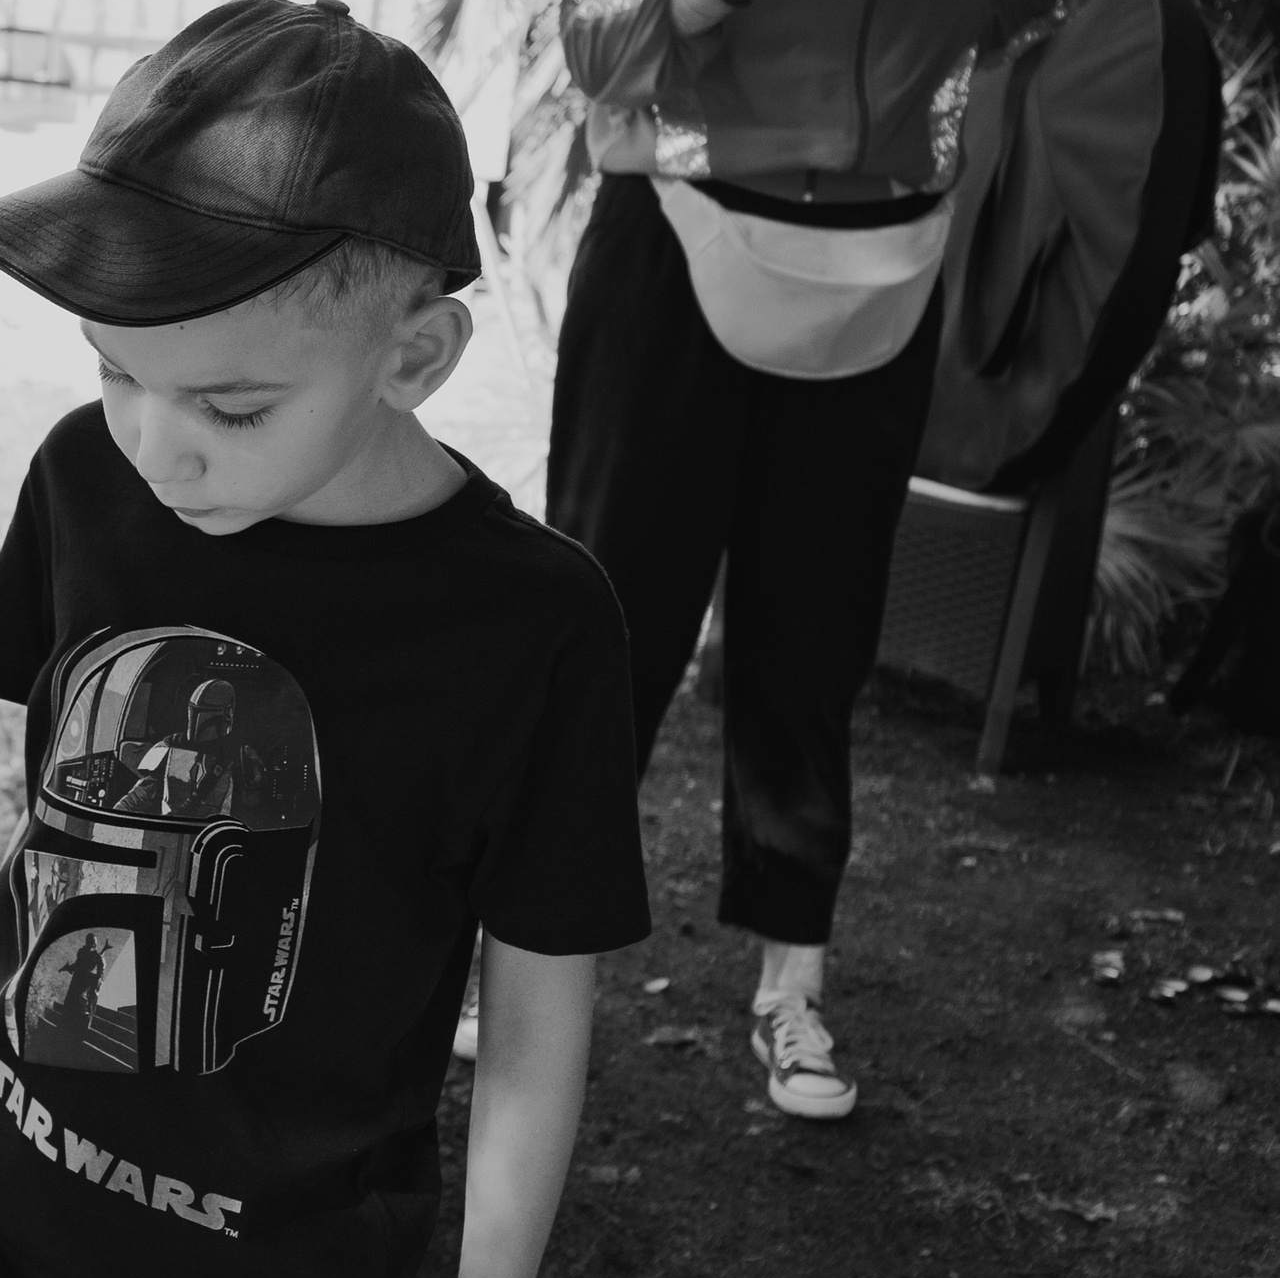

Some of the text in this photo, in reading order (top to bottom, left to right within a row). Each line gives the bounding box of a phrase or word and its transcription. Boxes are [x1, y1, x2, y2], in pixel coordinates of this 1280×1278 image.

[274, 907, 295, 967] WARS
[263, 967, 287, 1022] STAR
[63, 1127, 242, 1231] WARS
